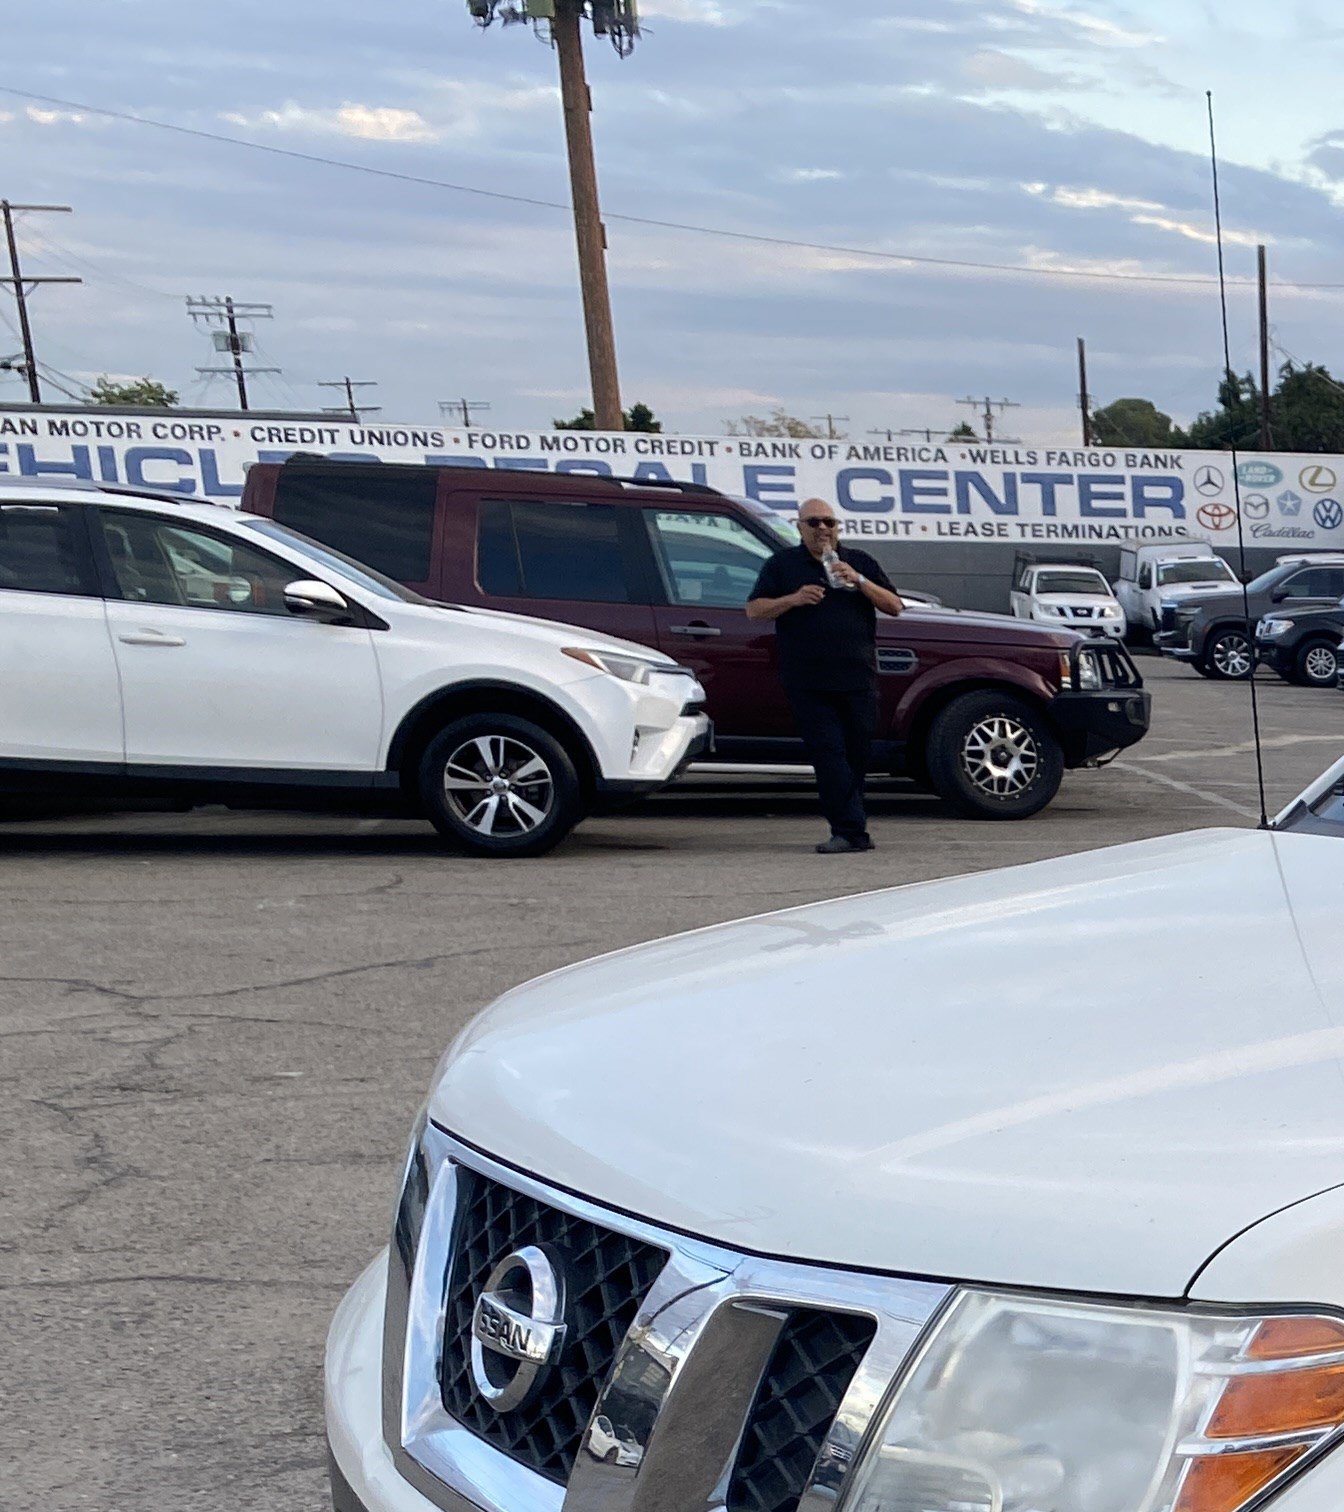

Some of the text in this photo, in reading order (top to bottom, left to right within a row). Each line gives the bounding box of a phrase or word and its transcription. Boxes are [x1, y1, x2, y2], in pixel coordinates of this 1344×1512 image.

[49, 419, 142, 439] MOTOR
[152, 422, 226, 441] CORP.
[251, 426, 339, 444] CREDIT
[350, 429, 444, 448] UNIONS
[467, 433, 530, 450] FORD
[540, 435, 626, 453] MOTOR
[634, 438, 719, 456] CREDIT
[738, 441, 801, 459] BANK
[811, 444, 839, 459] OF
[846, 446, 948, 463] AMERICA
[968, 449, 1037, 465] WELLS
[1046, 451, 1117, 468] FARGO
[1125, 454, 1183, 470] BANK
[835, 467, 1187, 519] CENTER
[936, 521, 1008, 536] LEASE
[1016, 523, 1188, 540] TERMINATIONS
[1250, 523, 1315, 539] Cadillac
